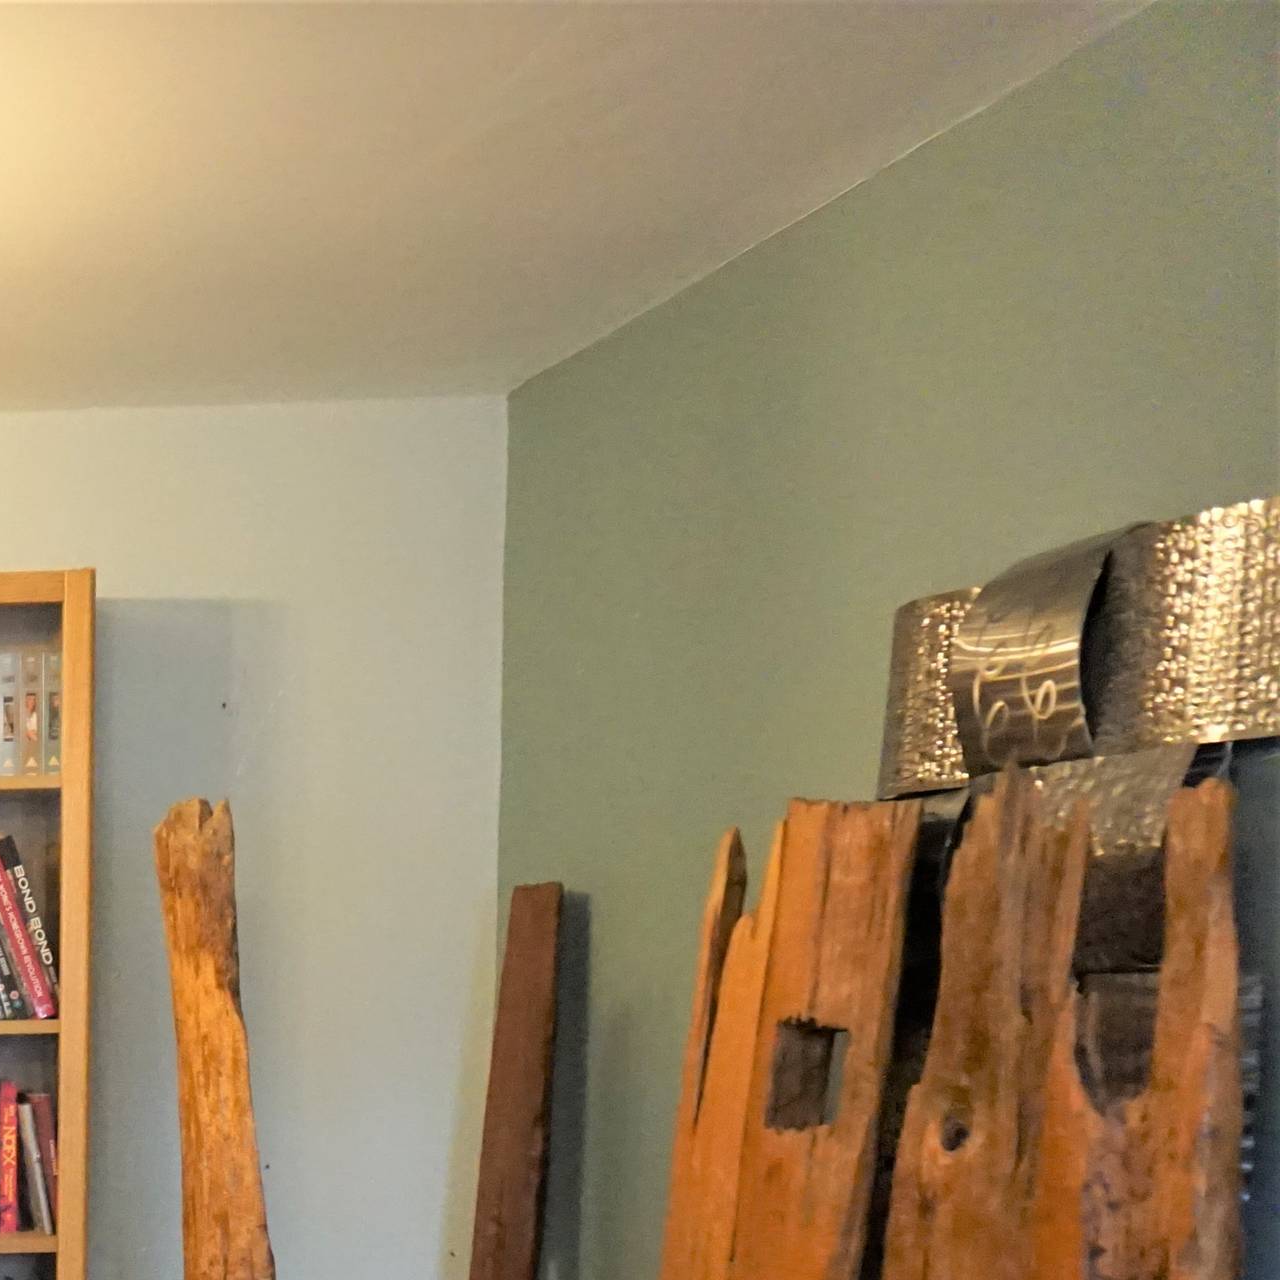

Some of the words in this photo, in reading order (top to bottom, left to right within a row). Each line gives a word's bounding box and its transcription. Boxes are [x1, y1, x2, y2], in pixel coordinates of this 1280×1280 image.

[13, 864, 37, 914] BOND
[30, 918, 54, 966] BOND
[2, 1126, 16, 1165] NOFX
